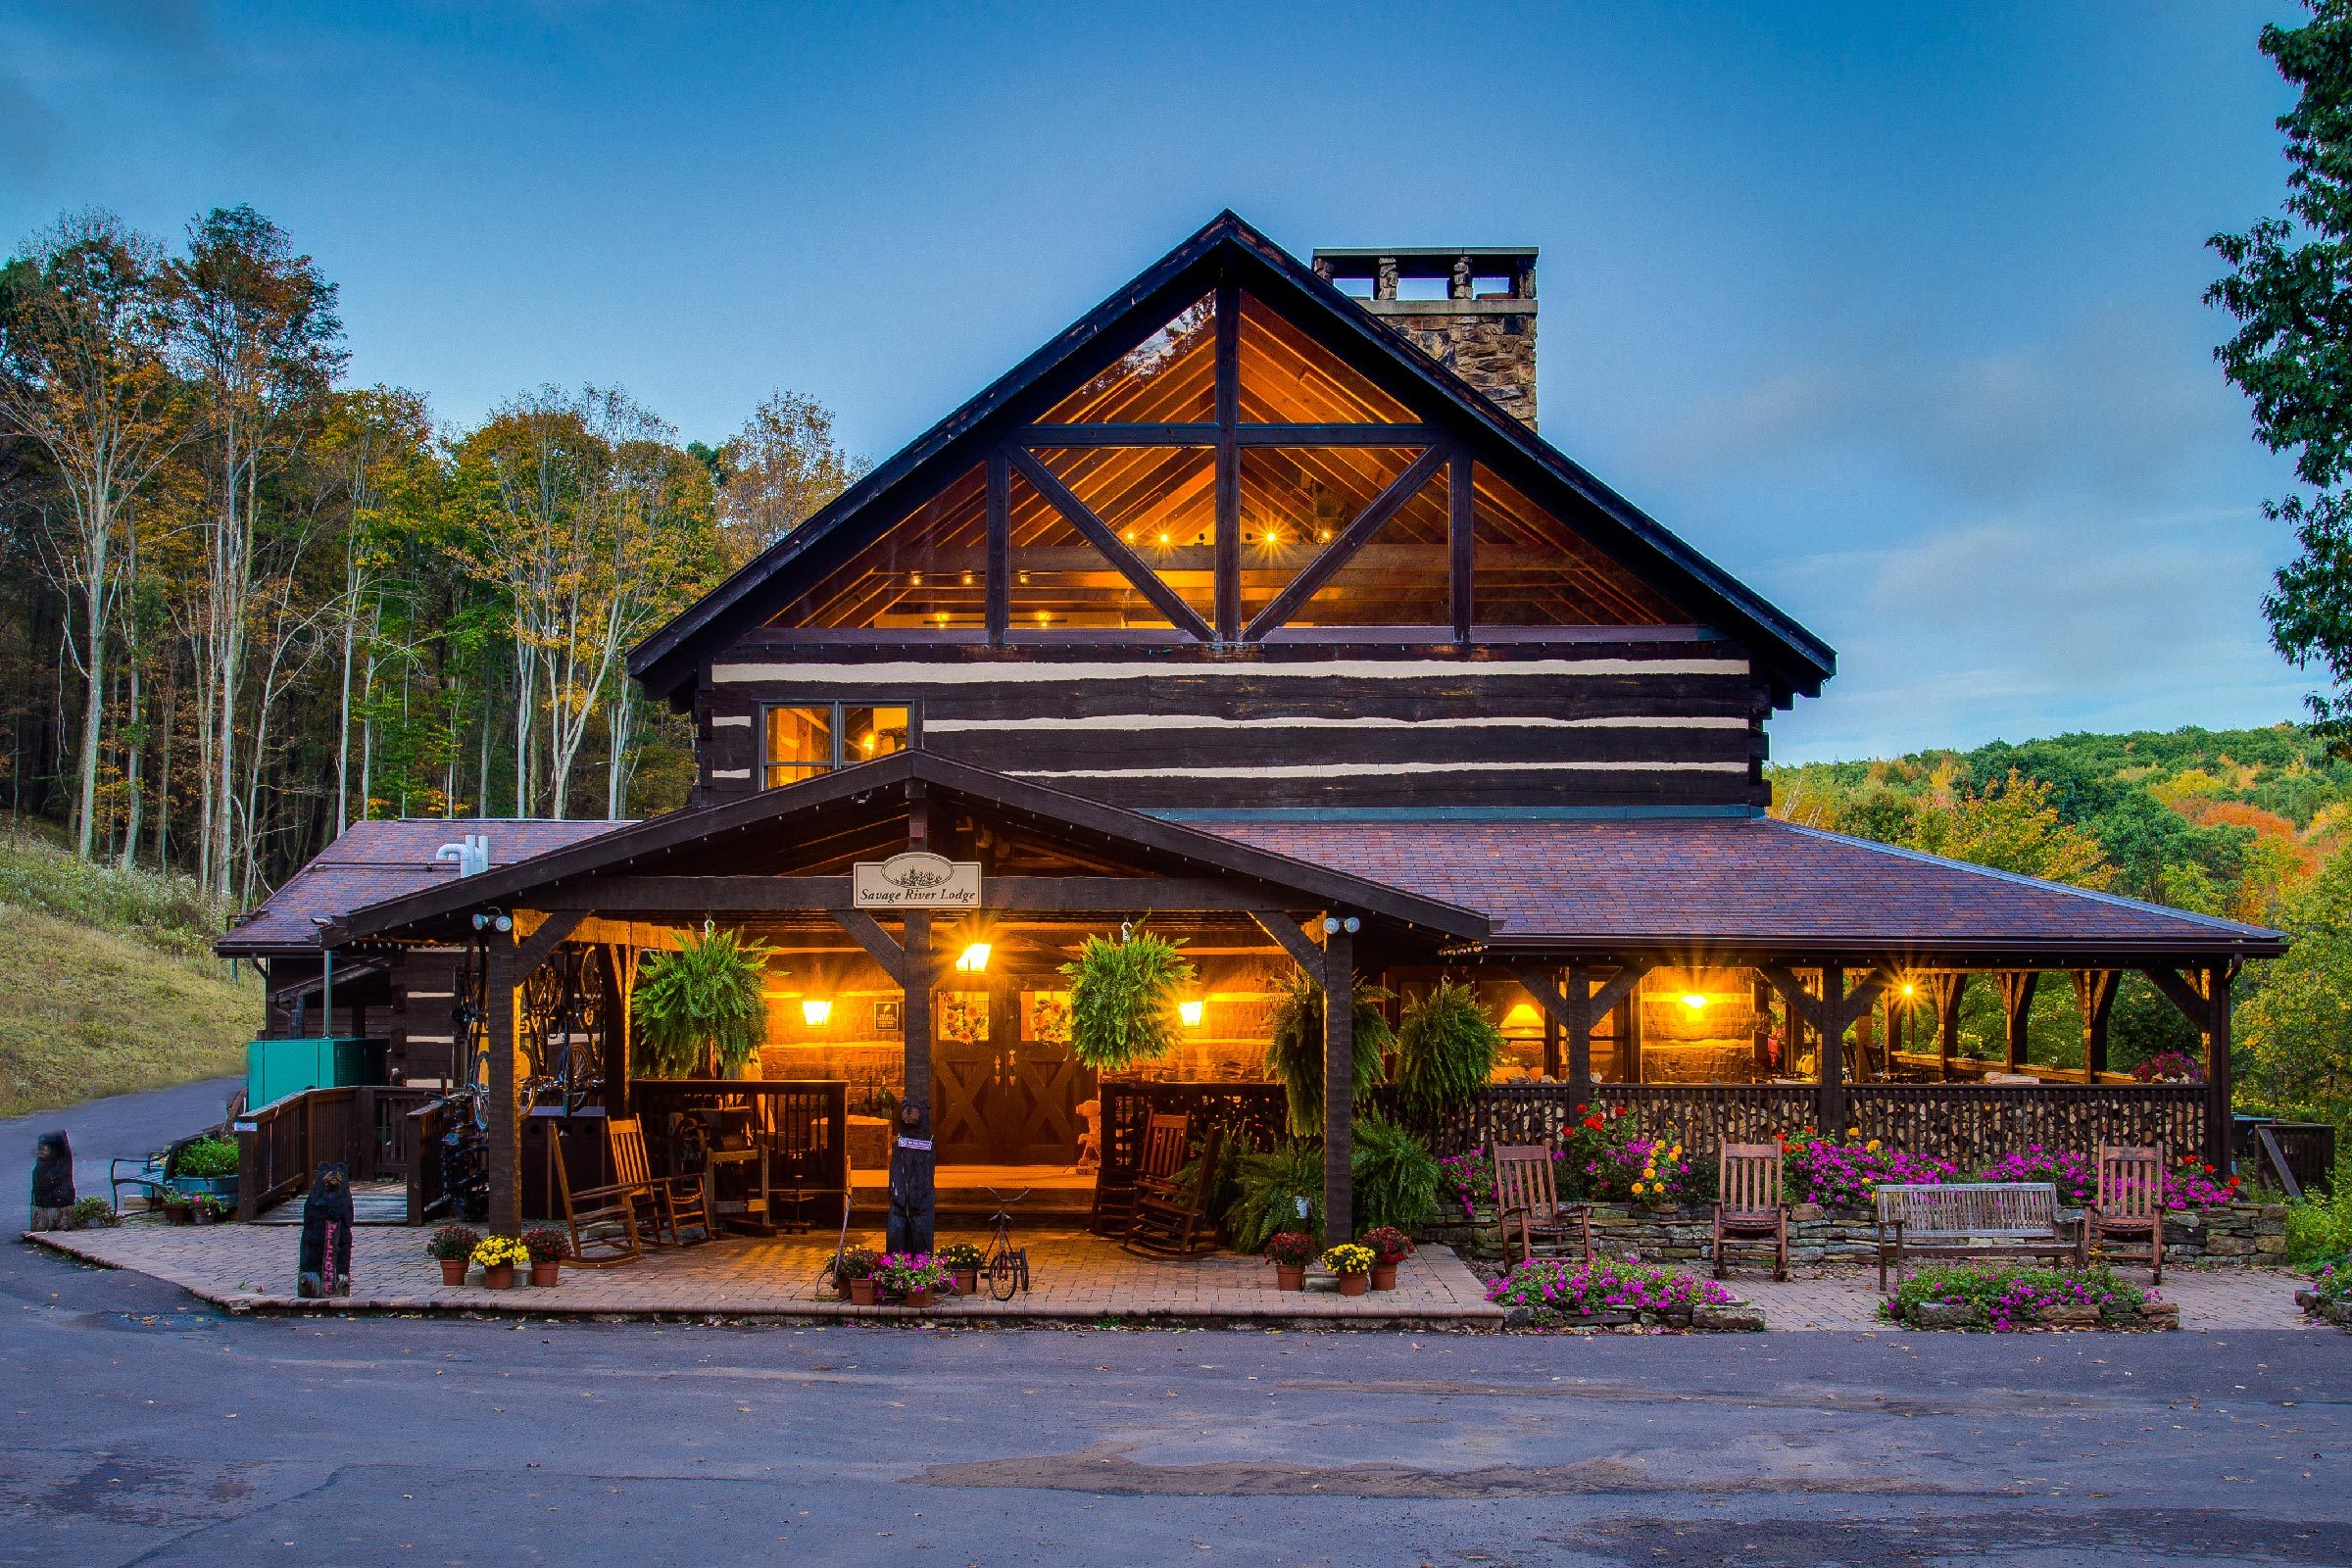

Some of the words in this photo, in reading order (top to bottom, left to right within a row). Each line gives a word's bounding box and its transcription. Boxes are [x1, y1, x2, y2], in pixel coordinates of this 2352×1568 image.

[860, 888, 901, 904] Savage
[905, 888, 937, 900] River
[941, 888, 975, 903] Lodge
[323, 1222, 337, 1293] WELCOME
